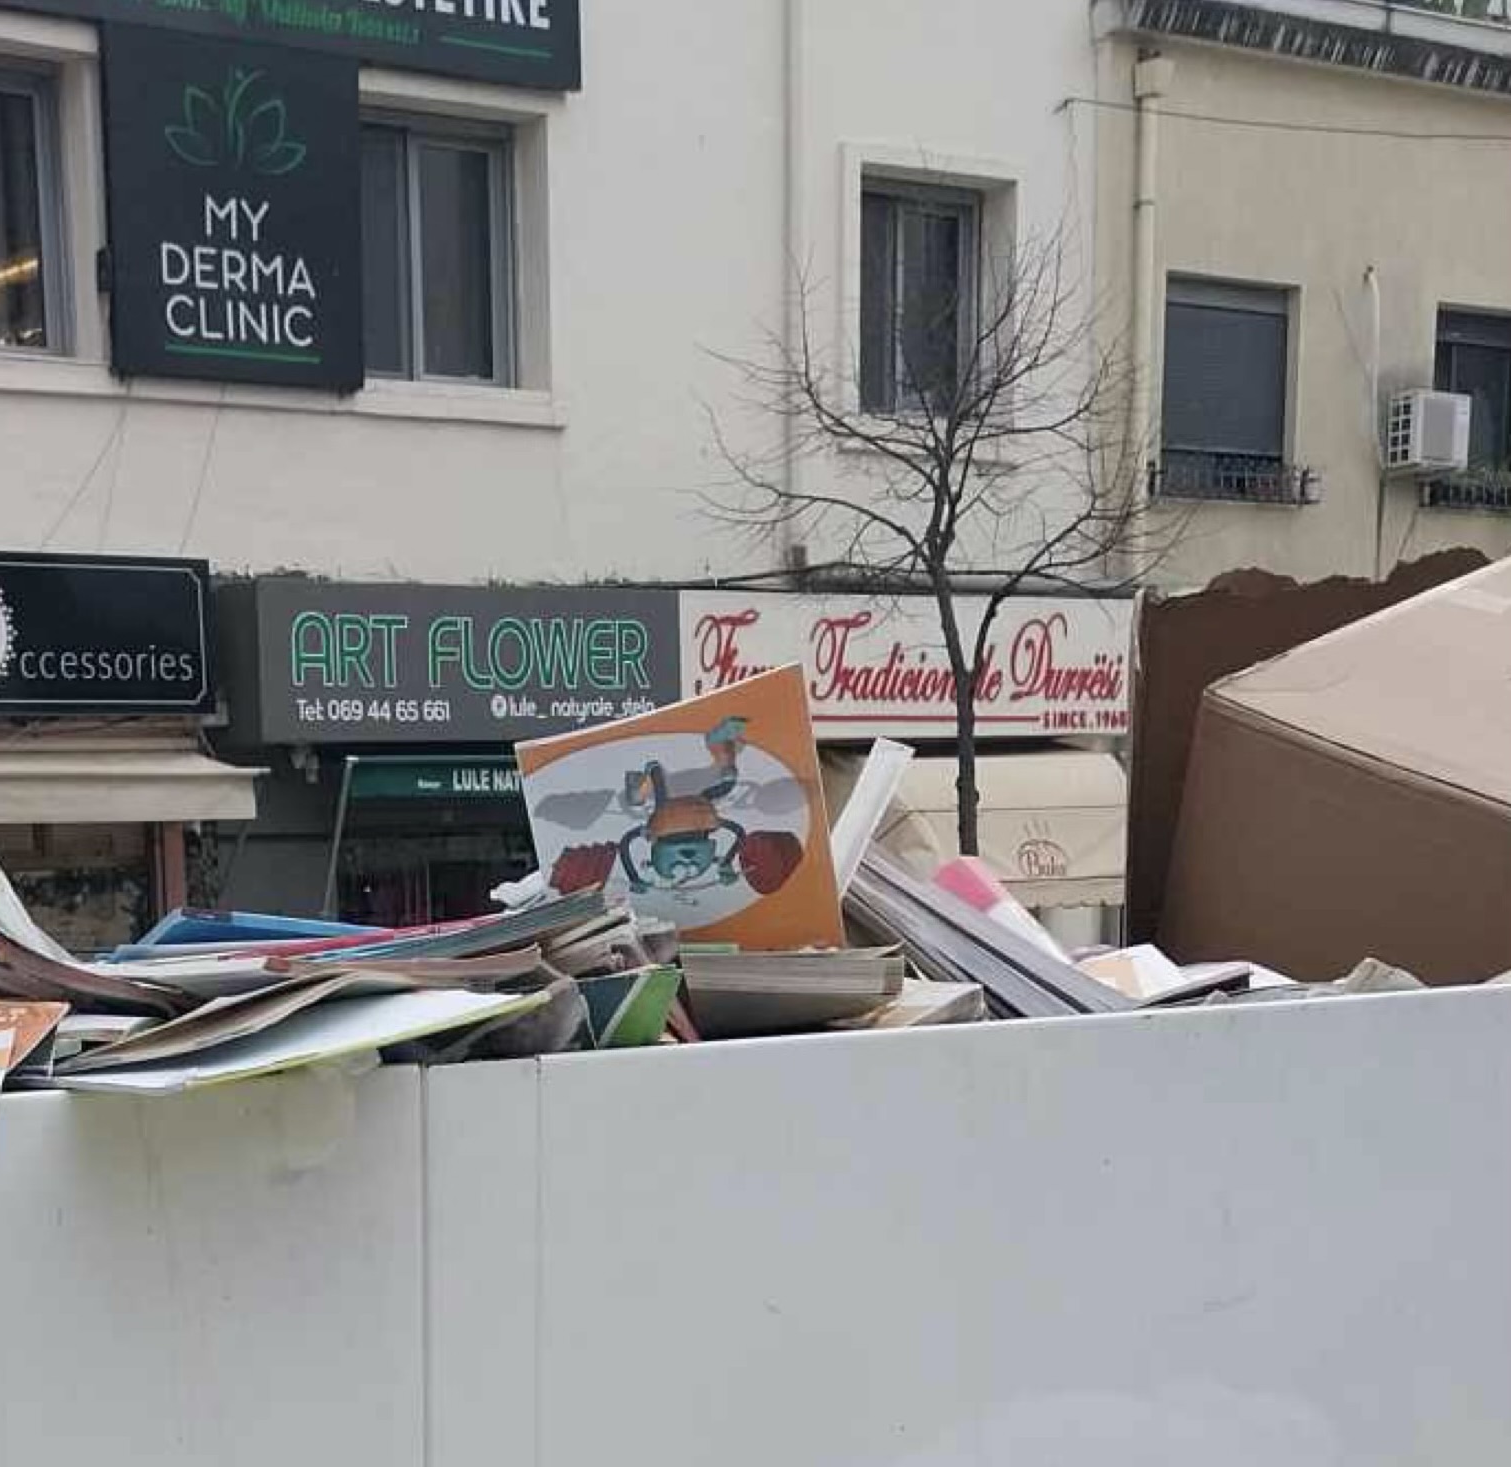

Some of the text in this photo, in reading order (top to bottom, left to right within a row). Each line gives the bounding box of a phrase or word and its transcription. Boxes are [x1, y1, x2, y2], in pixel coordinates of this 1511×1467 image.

[203, 195, 270, 241] MY
[160, 242, 317, 299] DERMA
[166, 295, 315, 348] CLINIC
[291, 611, 650, 691] ART FLOWER
[810, 610, 1003, 702] Tradicionle
[328, 700, 364, 721] 069
[367, 700, 392, 721] 44
[422, 700, 451, 721] 661
[452, 769, 491, 792] LULE
